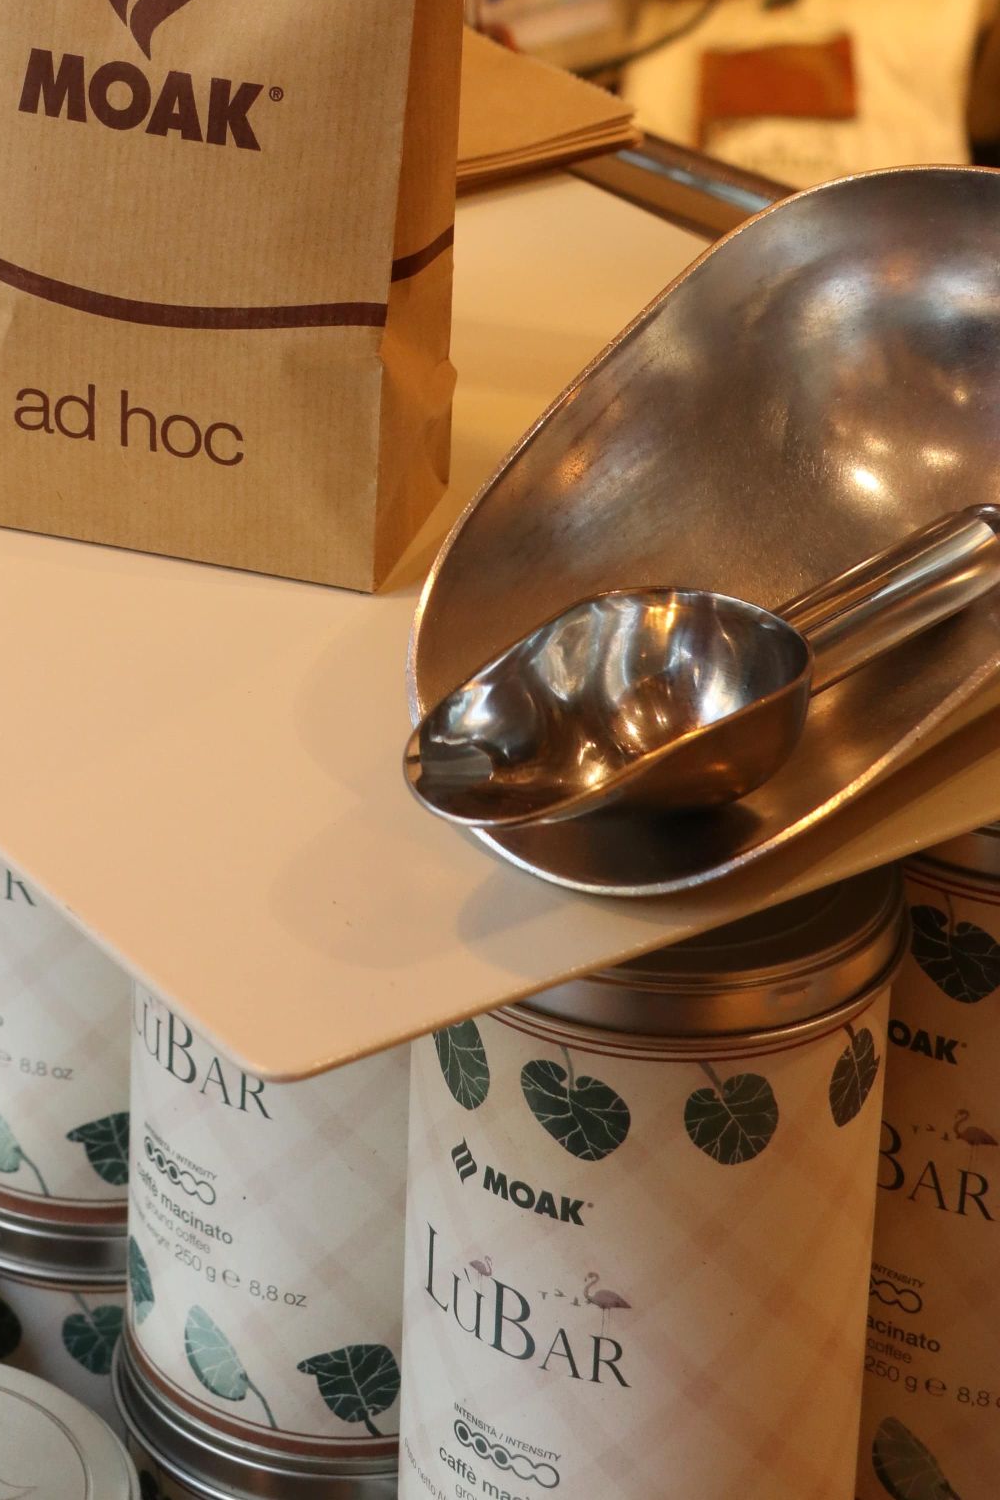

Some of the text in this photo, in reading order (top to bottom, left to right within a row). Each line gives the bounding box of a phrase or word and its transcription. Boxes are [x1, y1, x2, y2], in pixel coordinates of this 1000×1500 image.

[13, 384, 245, 467] ad hoc
[888, 1018, 960, 1066] OAK
[51, 1066, 75, 1082] oz
[876, 1120, 996, 1222] BAR
[161, 1192, 234, 1245] macinato
[175, 1226, 212, 1255] coffee
[174, 1243, 202, 1272] 250
[205, 1265, 217, 1283] g
[283, 1291, 308, 1308] oz
[866, 1314, 941, 1353] acinato
[864, 1354, 900, 1383] 250
[904, 1375, 918, 1394] g
[439, 1446, 477, 1485] caffè
[504, 1434, 562, 1462] INTENSITY
